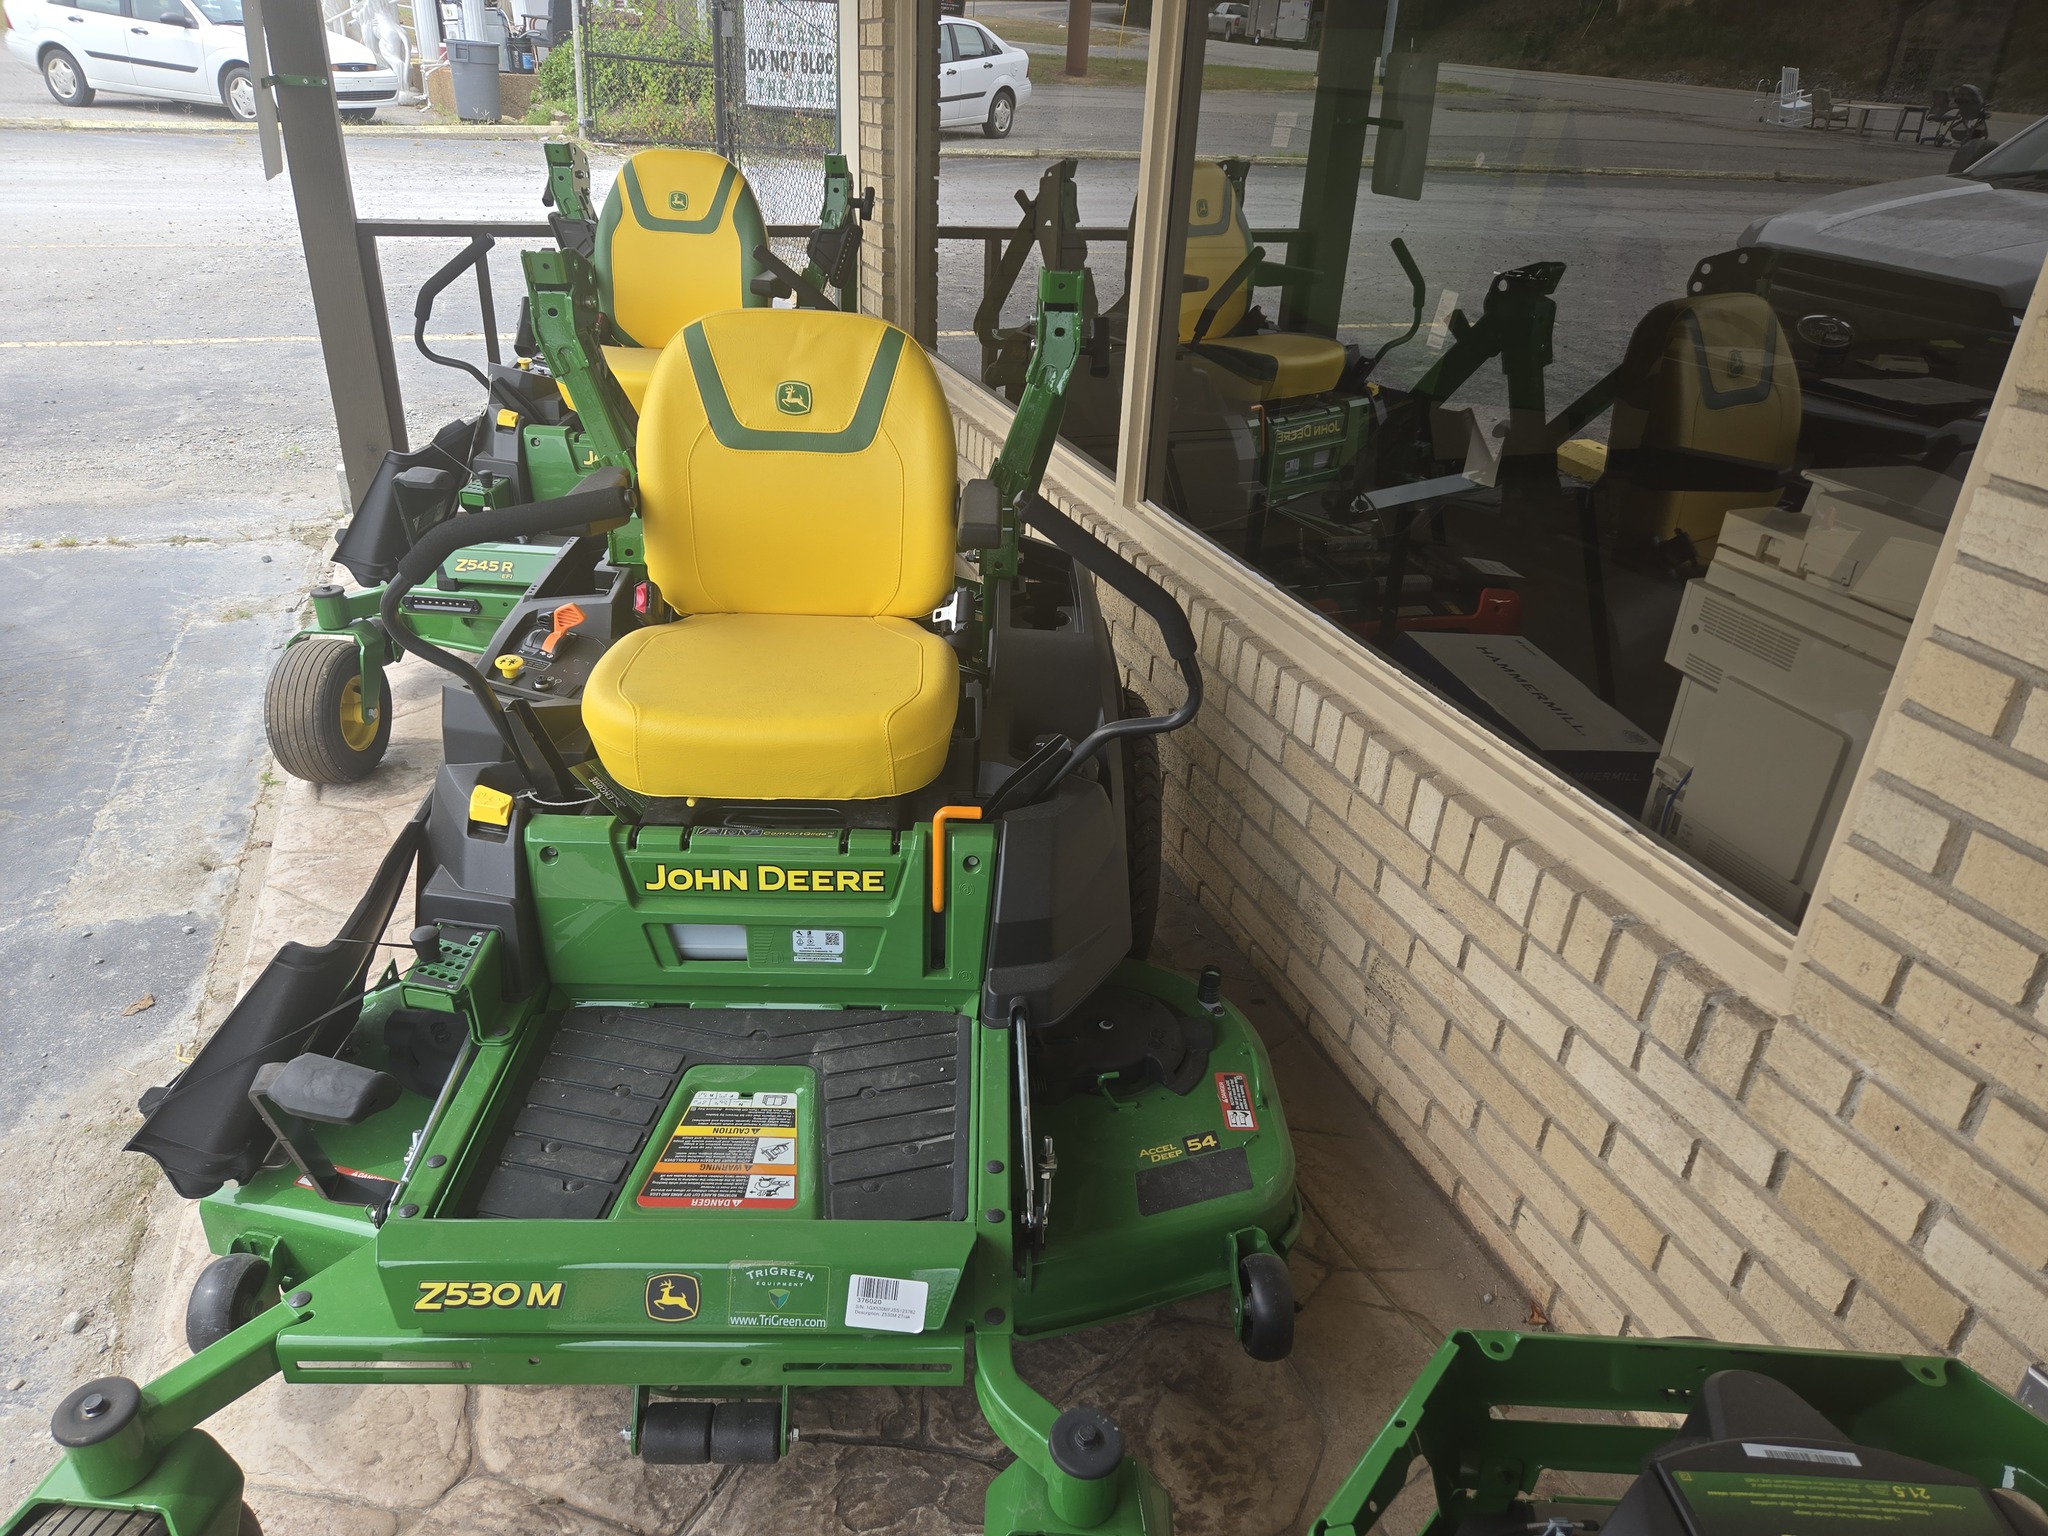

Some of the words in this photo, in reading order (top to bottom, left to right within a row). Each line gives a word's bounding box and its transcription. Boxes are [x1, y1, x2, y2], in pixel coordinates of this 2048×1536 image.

[748, 48, 767, 71] DO
[769, 50, 798, 73] NOT
[800, 52, 834, 75] BLOC
[454, 558, 500, 573] Z545
[501, 561, 514, 573] R
[1475, 645, 1588, 737] HAMMERMILL
[588, 776, 615, 801] ENCORE
[645, 863, 749, 892] JOHN
[757, 865, 885, 893] DEERE
[1139, 1143, 1178, 1158] ACCEL
[1186, 1134, 1218, 1152] 54
[1150, 1149, 1183, 1163] DEEP
[357, 1172, 386, 1181] DAN
[413, 1281, 522, 1313] Z530
[526, 1281, 566, 1309] M
[856, 1297, 882, 1305] 376020
[730, 1314, 827, 1328] www.TriGreen.com
[1891, 1484, 1932, 1501] 21.5
